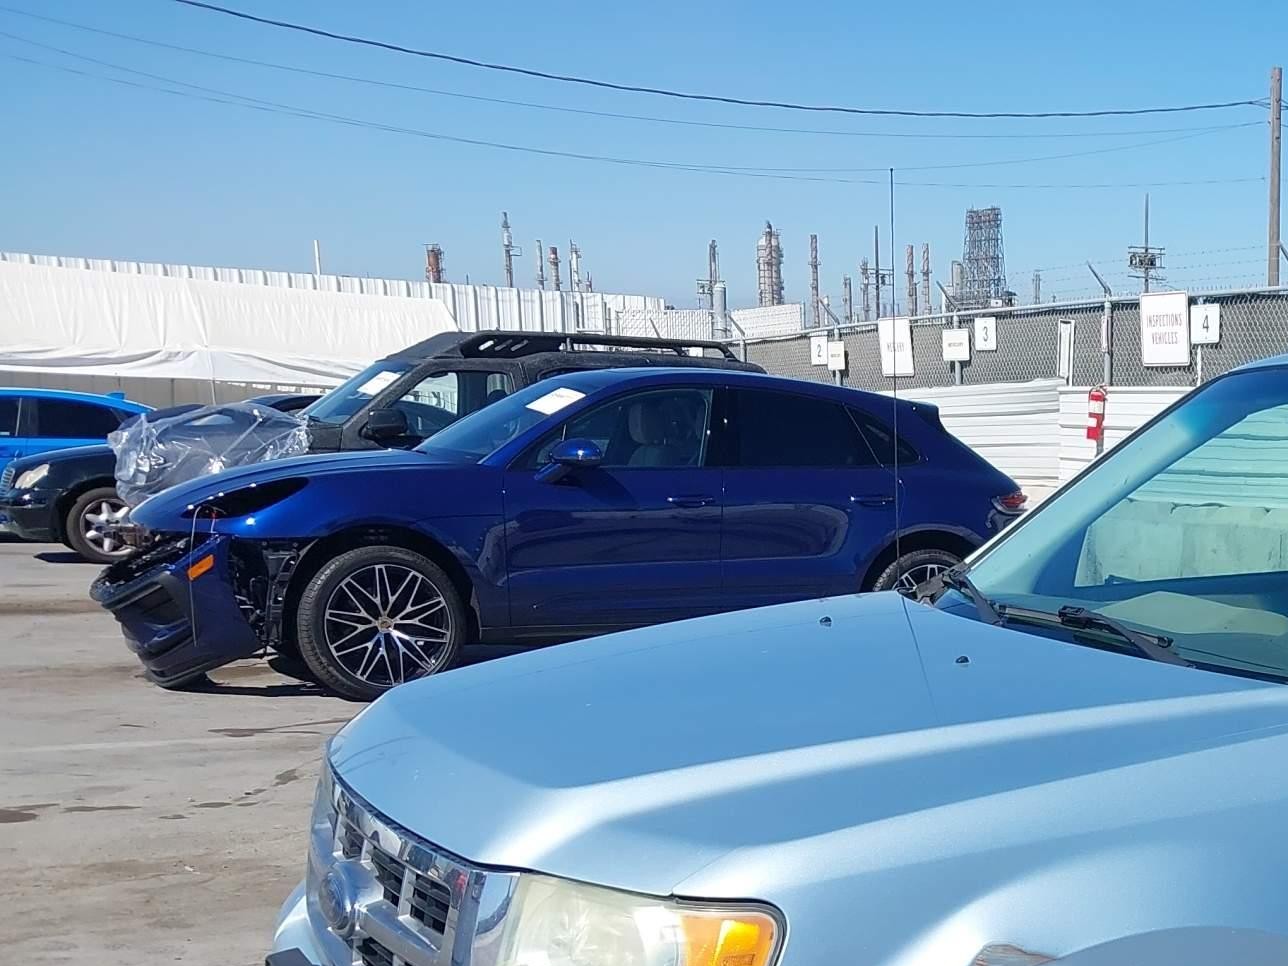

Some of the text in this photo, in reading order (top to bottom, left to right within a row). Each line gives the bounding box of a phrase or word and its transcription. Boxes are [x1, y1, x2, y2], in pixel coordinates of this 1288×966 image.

[1146, 312, 1183, 328] INSPECTIONS
[1202, 314, 1210, 333] 4
[982, 326, 989, 342] 3
[1151, 331, 1179, 345] VEHICLES
[816, 343, 822, 359] 2
